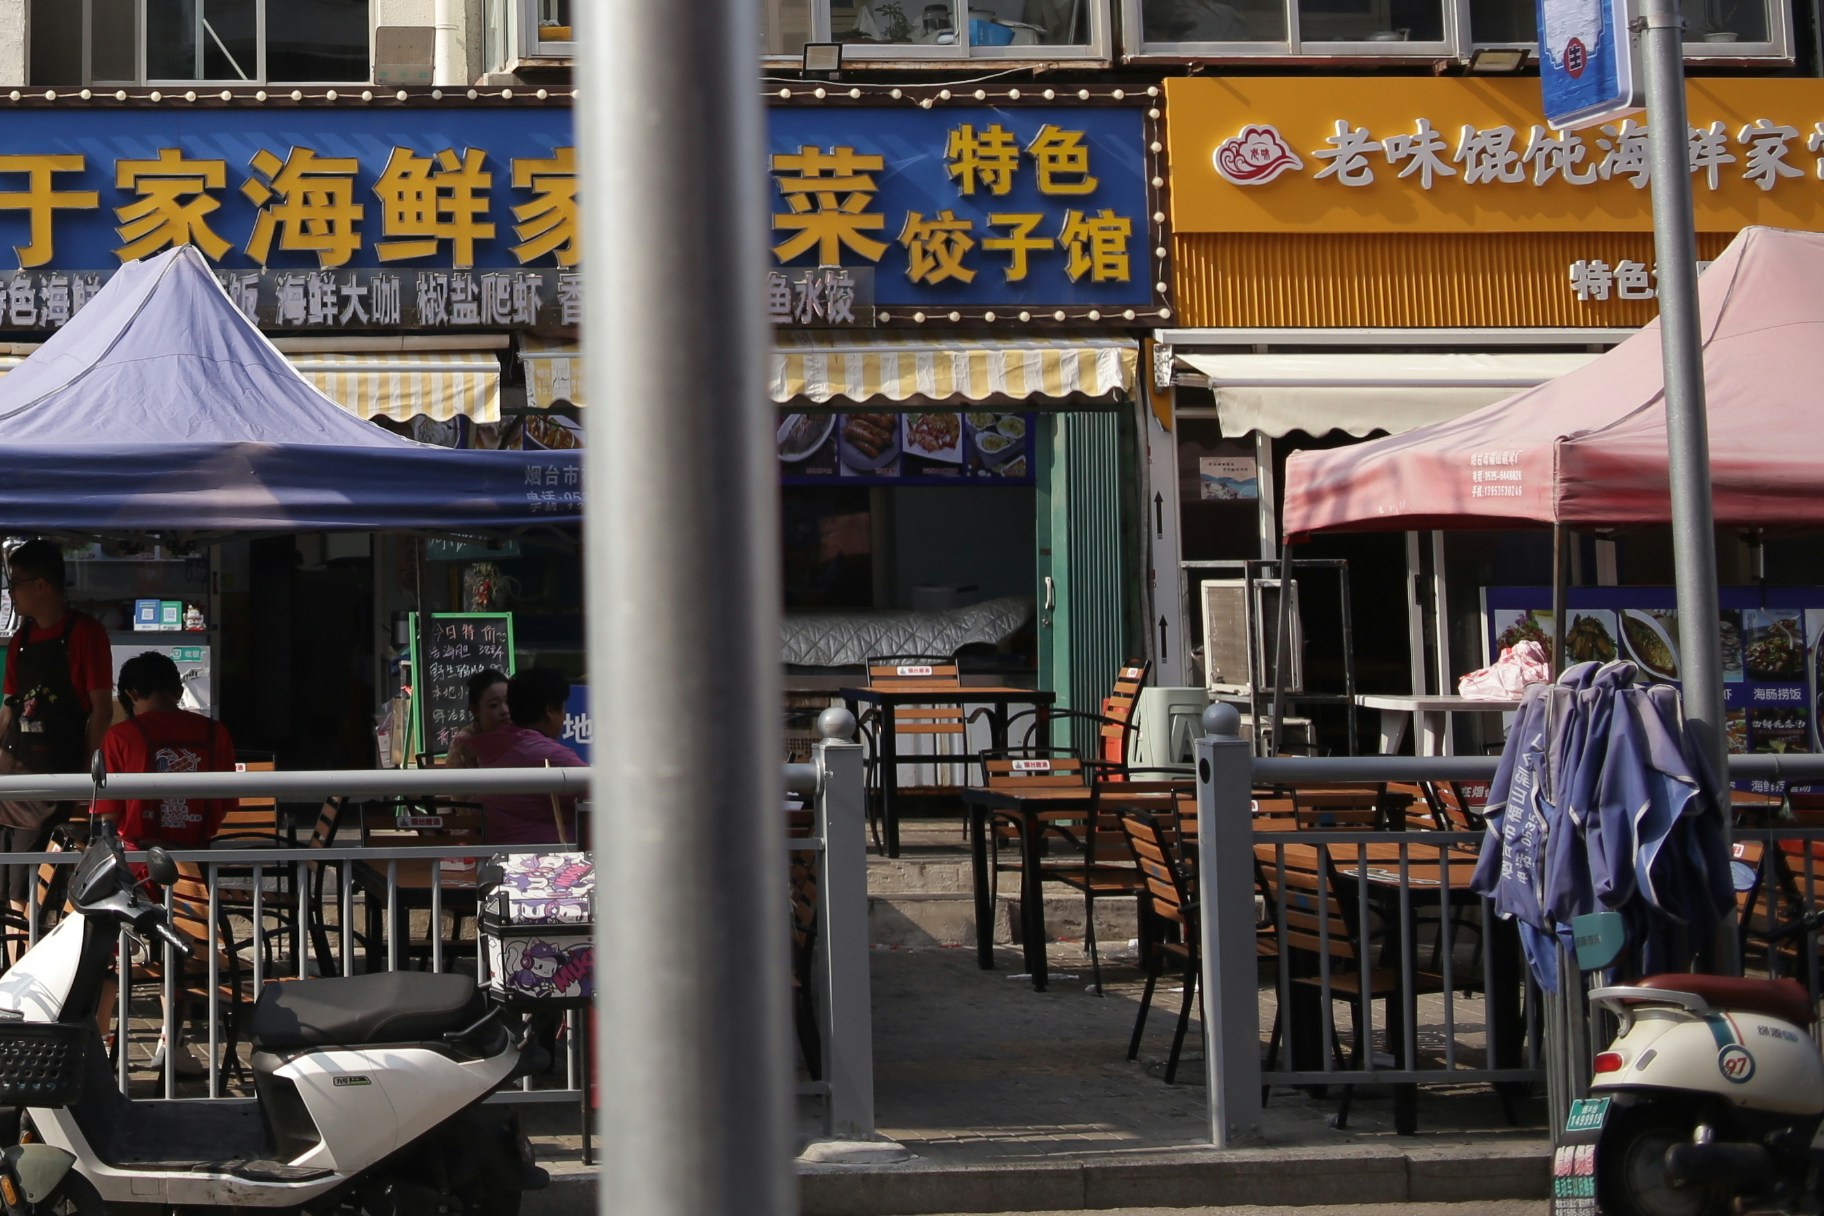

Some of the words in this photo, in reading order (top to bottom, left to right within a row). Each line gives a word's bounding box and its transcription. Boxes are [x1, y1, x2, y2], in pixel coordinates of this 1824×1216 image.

[943, 122, 1100, 197] 特色
[1311, 117, 1824, 192] 老味馄饨海鲜家
[898, 208, 1132, 284] 饺子馆
[274, 271, 402, 326] 海鲜大咖
[415, 271, 544, 326] 椒盐爬虾
[766, 270, 856, 326] 鱼水饺
[1569, 259, 1659, 302] 特色
[524, 464, 583, 486] 烟台市
[1725, 1056, 1747, 1077] 97
